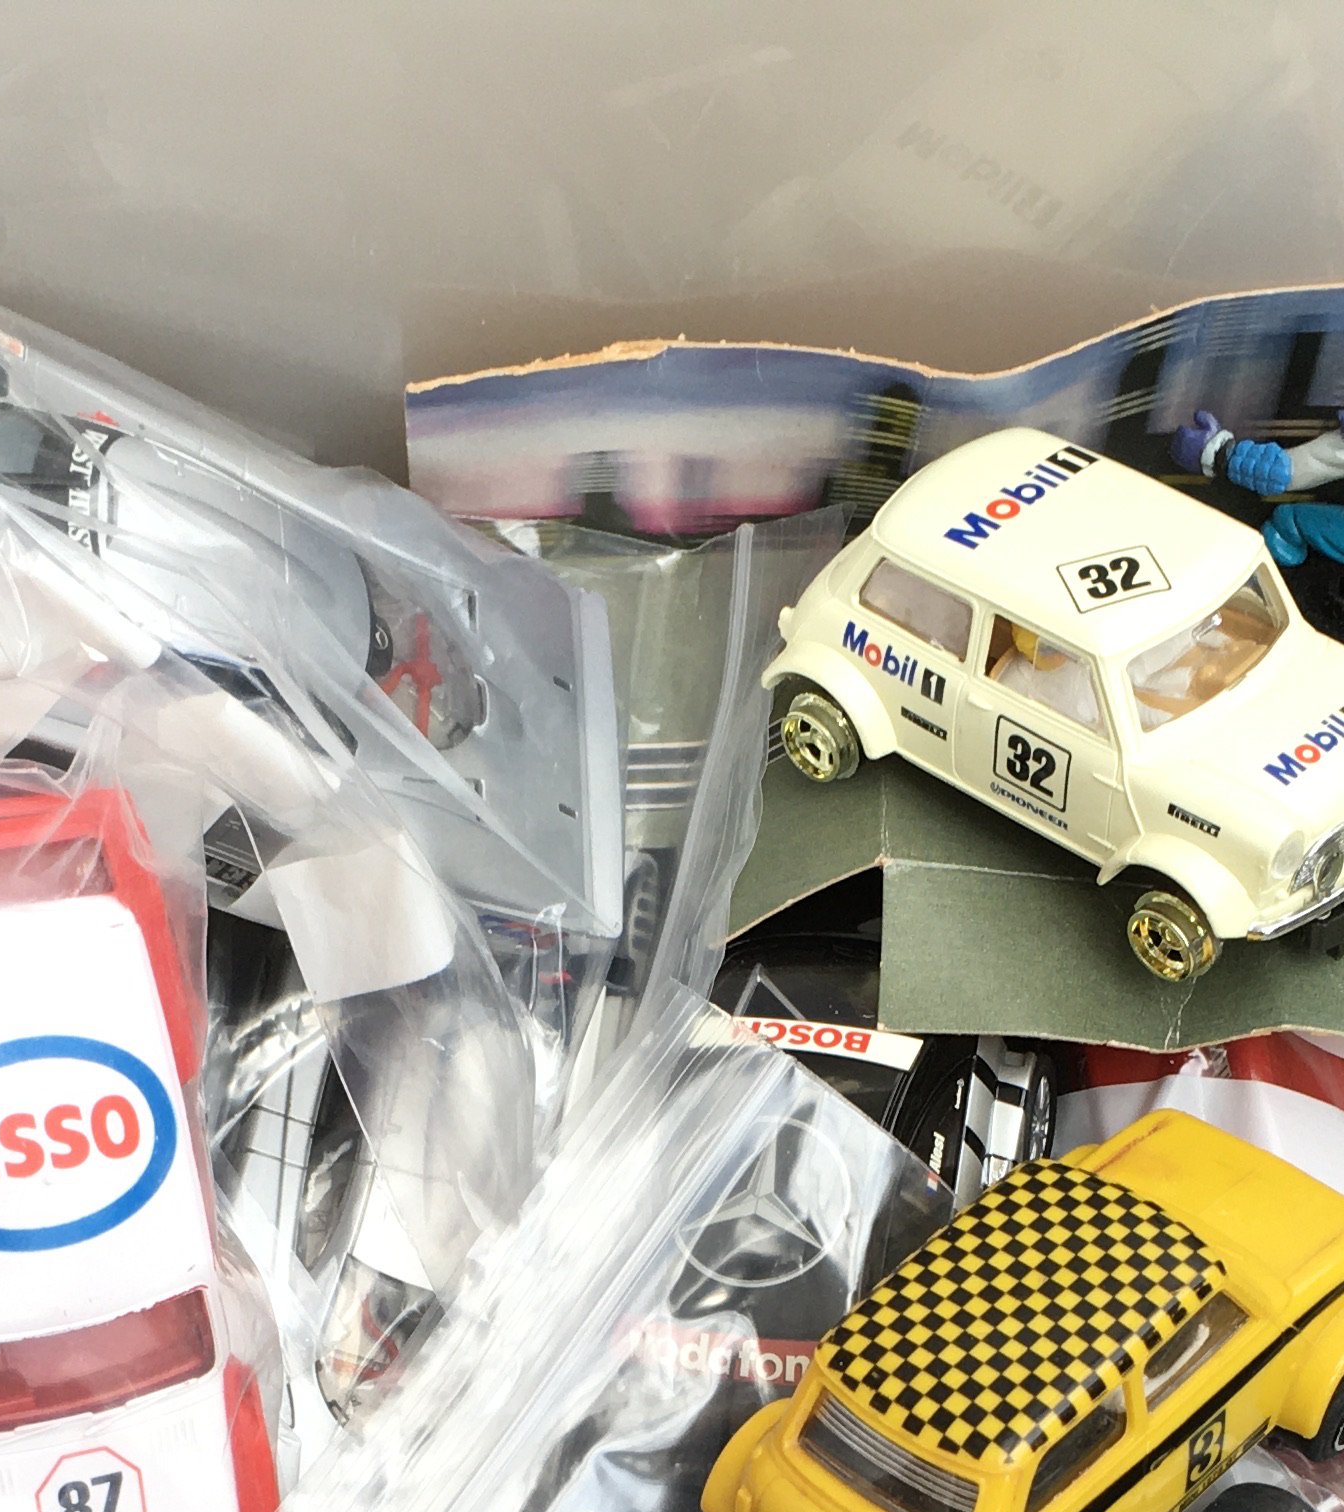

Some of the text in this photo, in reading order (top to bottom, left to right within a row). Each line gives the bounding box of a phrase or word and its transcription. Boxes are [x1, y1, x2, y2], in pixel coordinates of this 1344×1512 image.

[943, 463, 1070, 550] Mobil
[1077, 556, 1152, 600] 32
[842, 620, 919, 687] Mobil
[1006, 733, 1057, 798] 32
[999, 786, 1068, 831] PIONEER
[1189, 1421, 1223, 1482] 3
